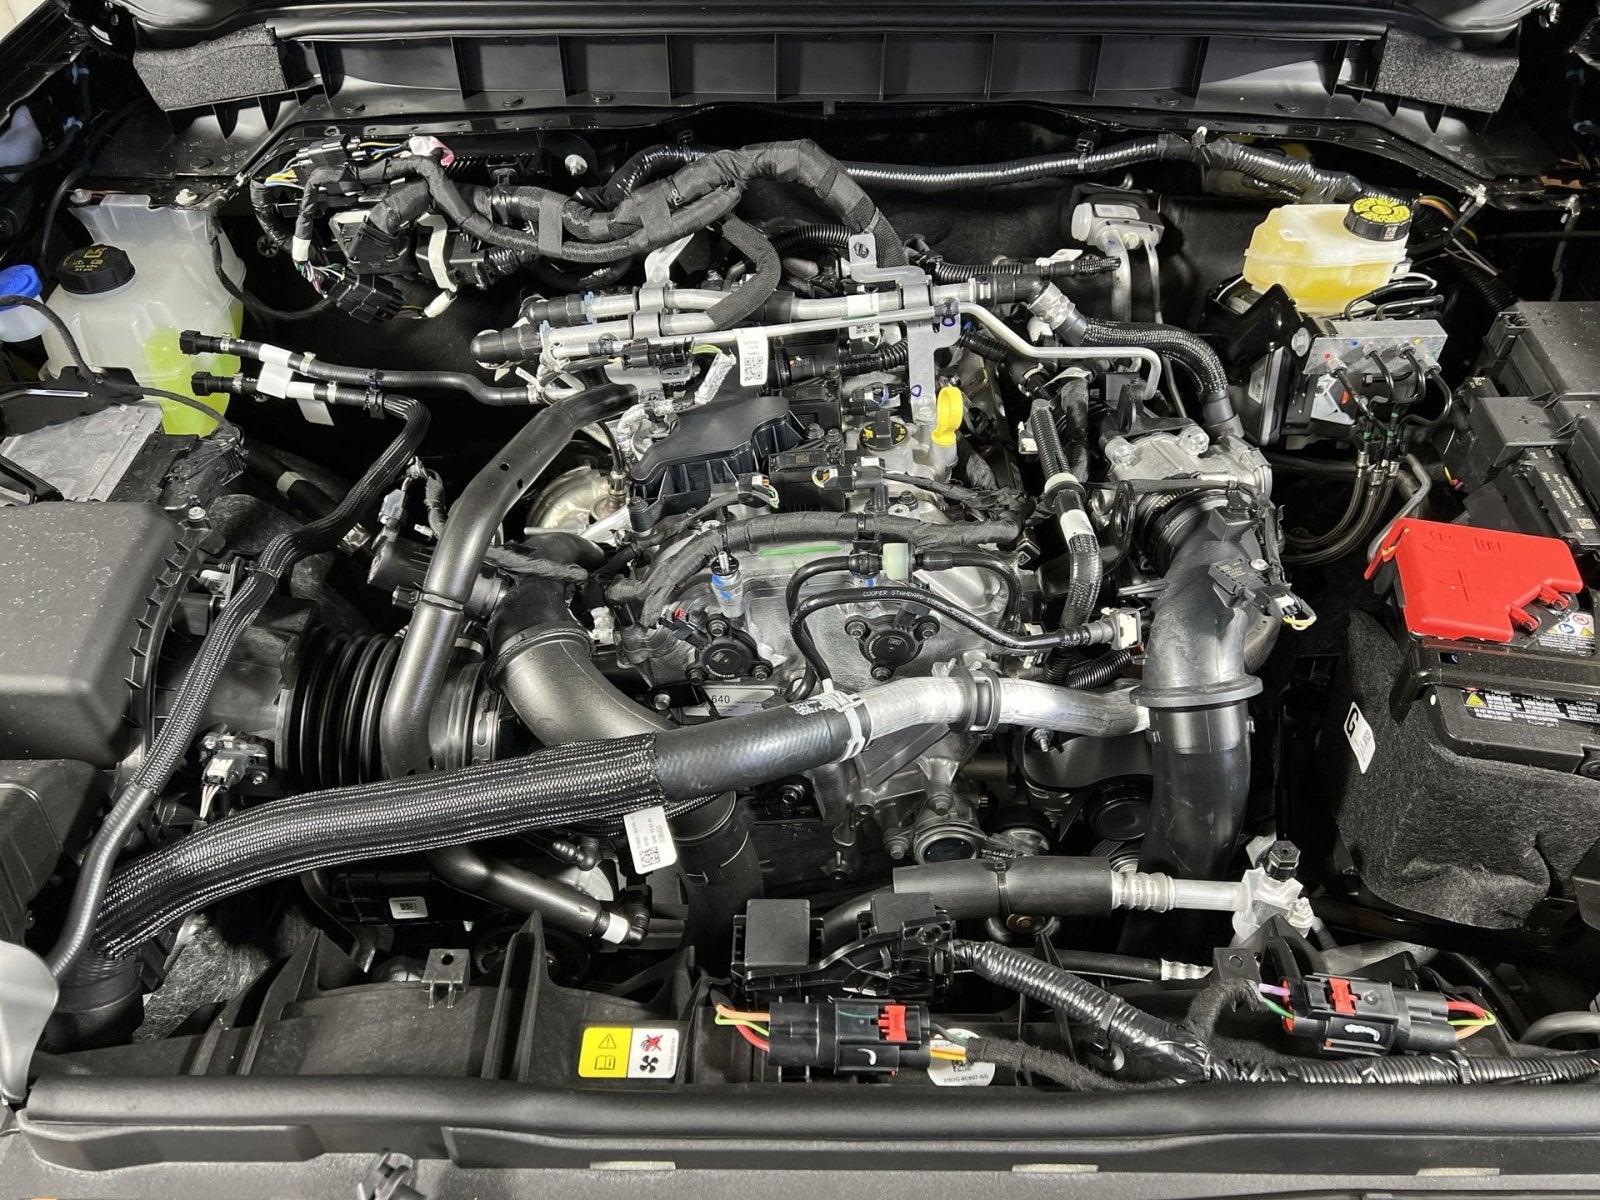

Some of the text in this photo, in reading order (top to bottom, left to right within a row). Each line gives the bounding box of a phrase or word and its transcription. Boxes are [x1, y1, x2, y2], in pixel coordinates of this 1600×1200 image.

[862, 589, 925, 600] COOPER STANDARD
[711, 695, 730, 703] 640
[1347, 707, 1359, 738] G
